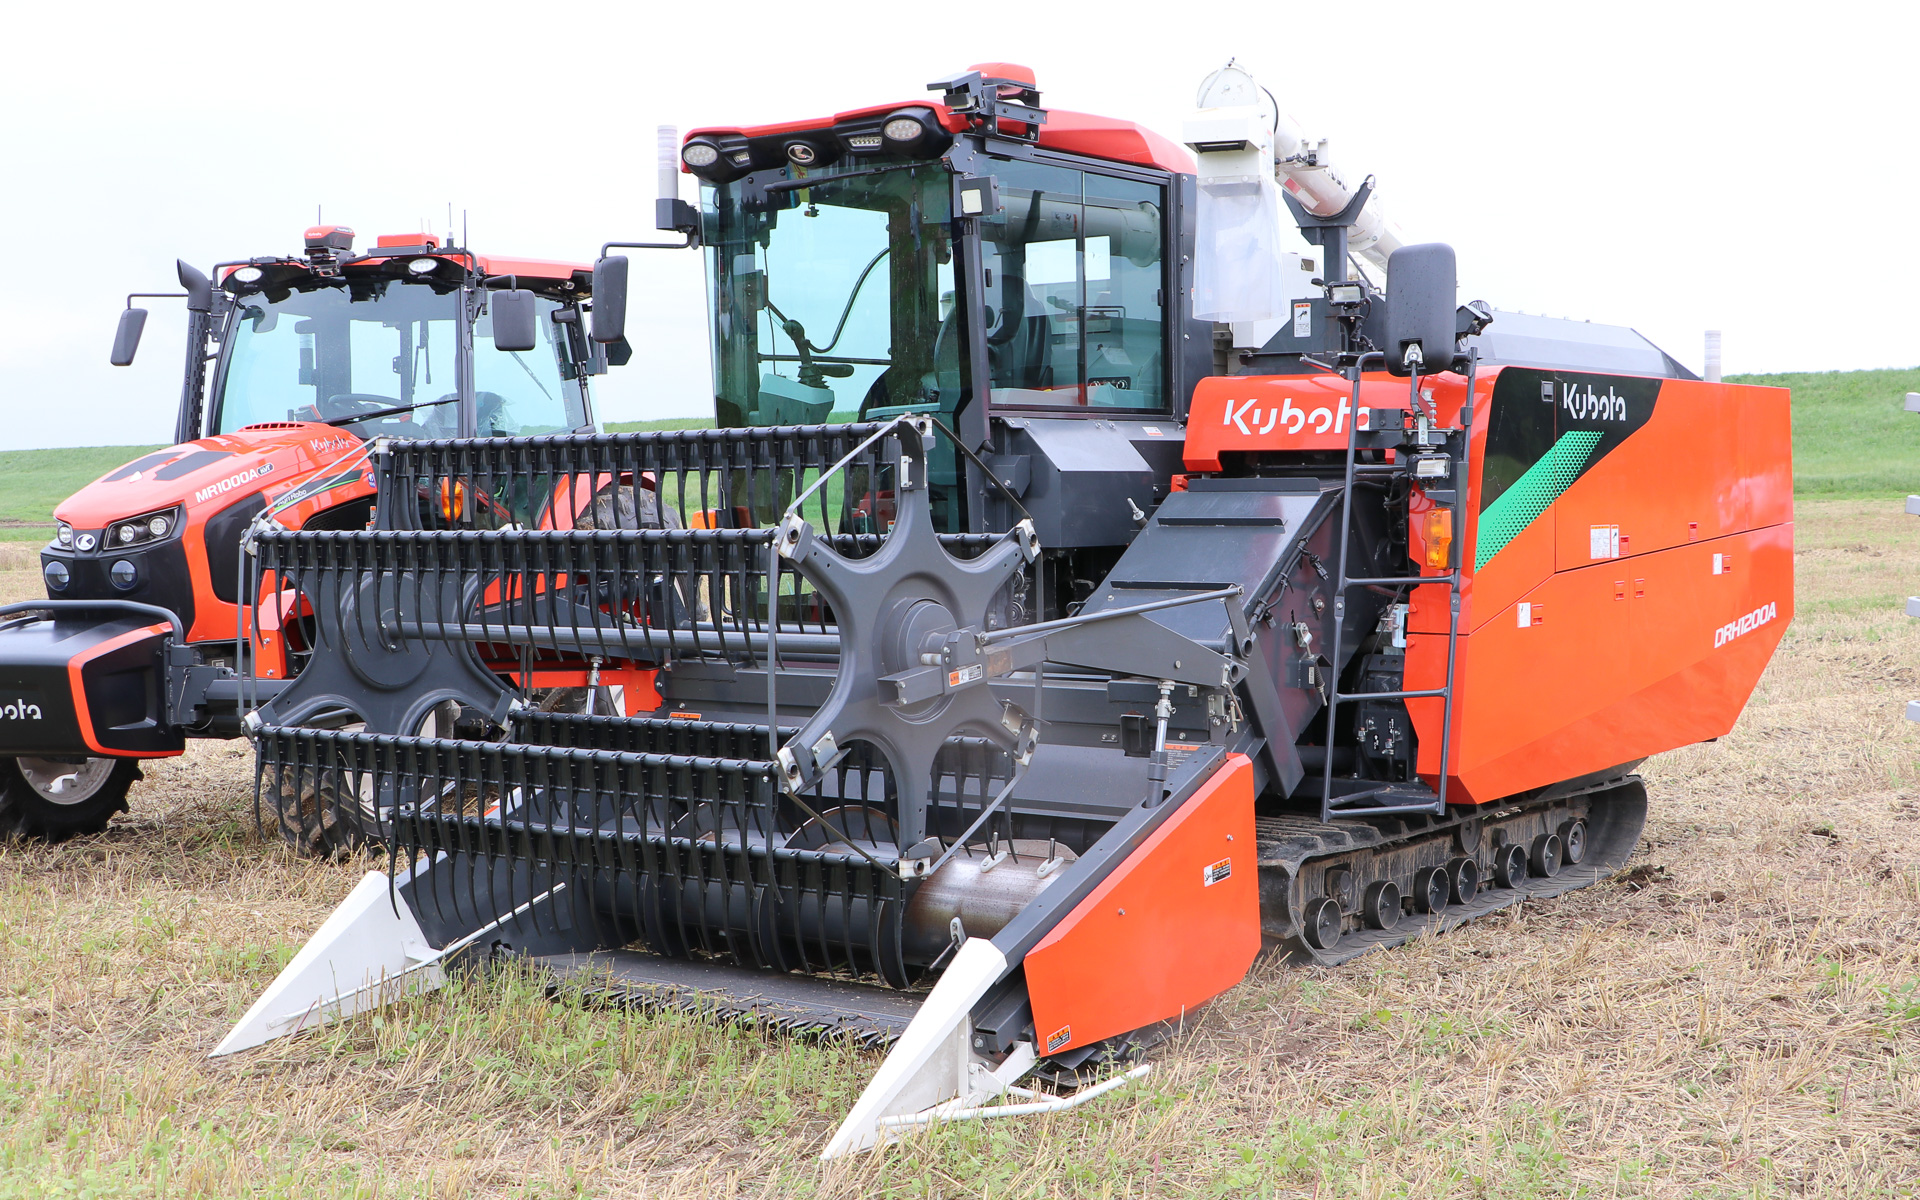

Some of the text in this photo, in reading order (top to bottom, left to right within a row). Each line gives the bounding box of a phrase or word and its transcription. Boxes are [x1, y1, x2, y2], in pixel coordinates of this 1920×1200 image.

[1563, 382, 1626, 421] Kubota
[310, 434, 350, 453] Kubota
[195, 468, 259, 503] MR1000A
[1713, 601, 1777, 649] DRH1200A
[0, 698, 43, 720] ota
